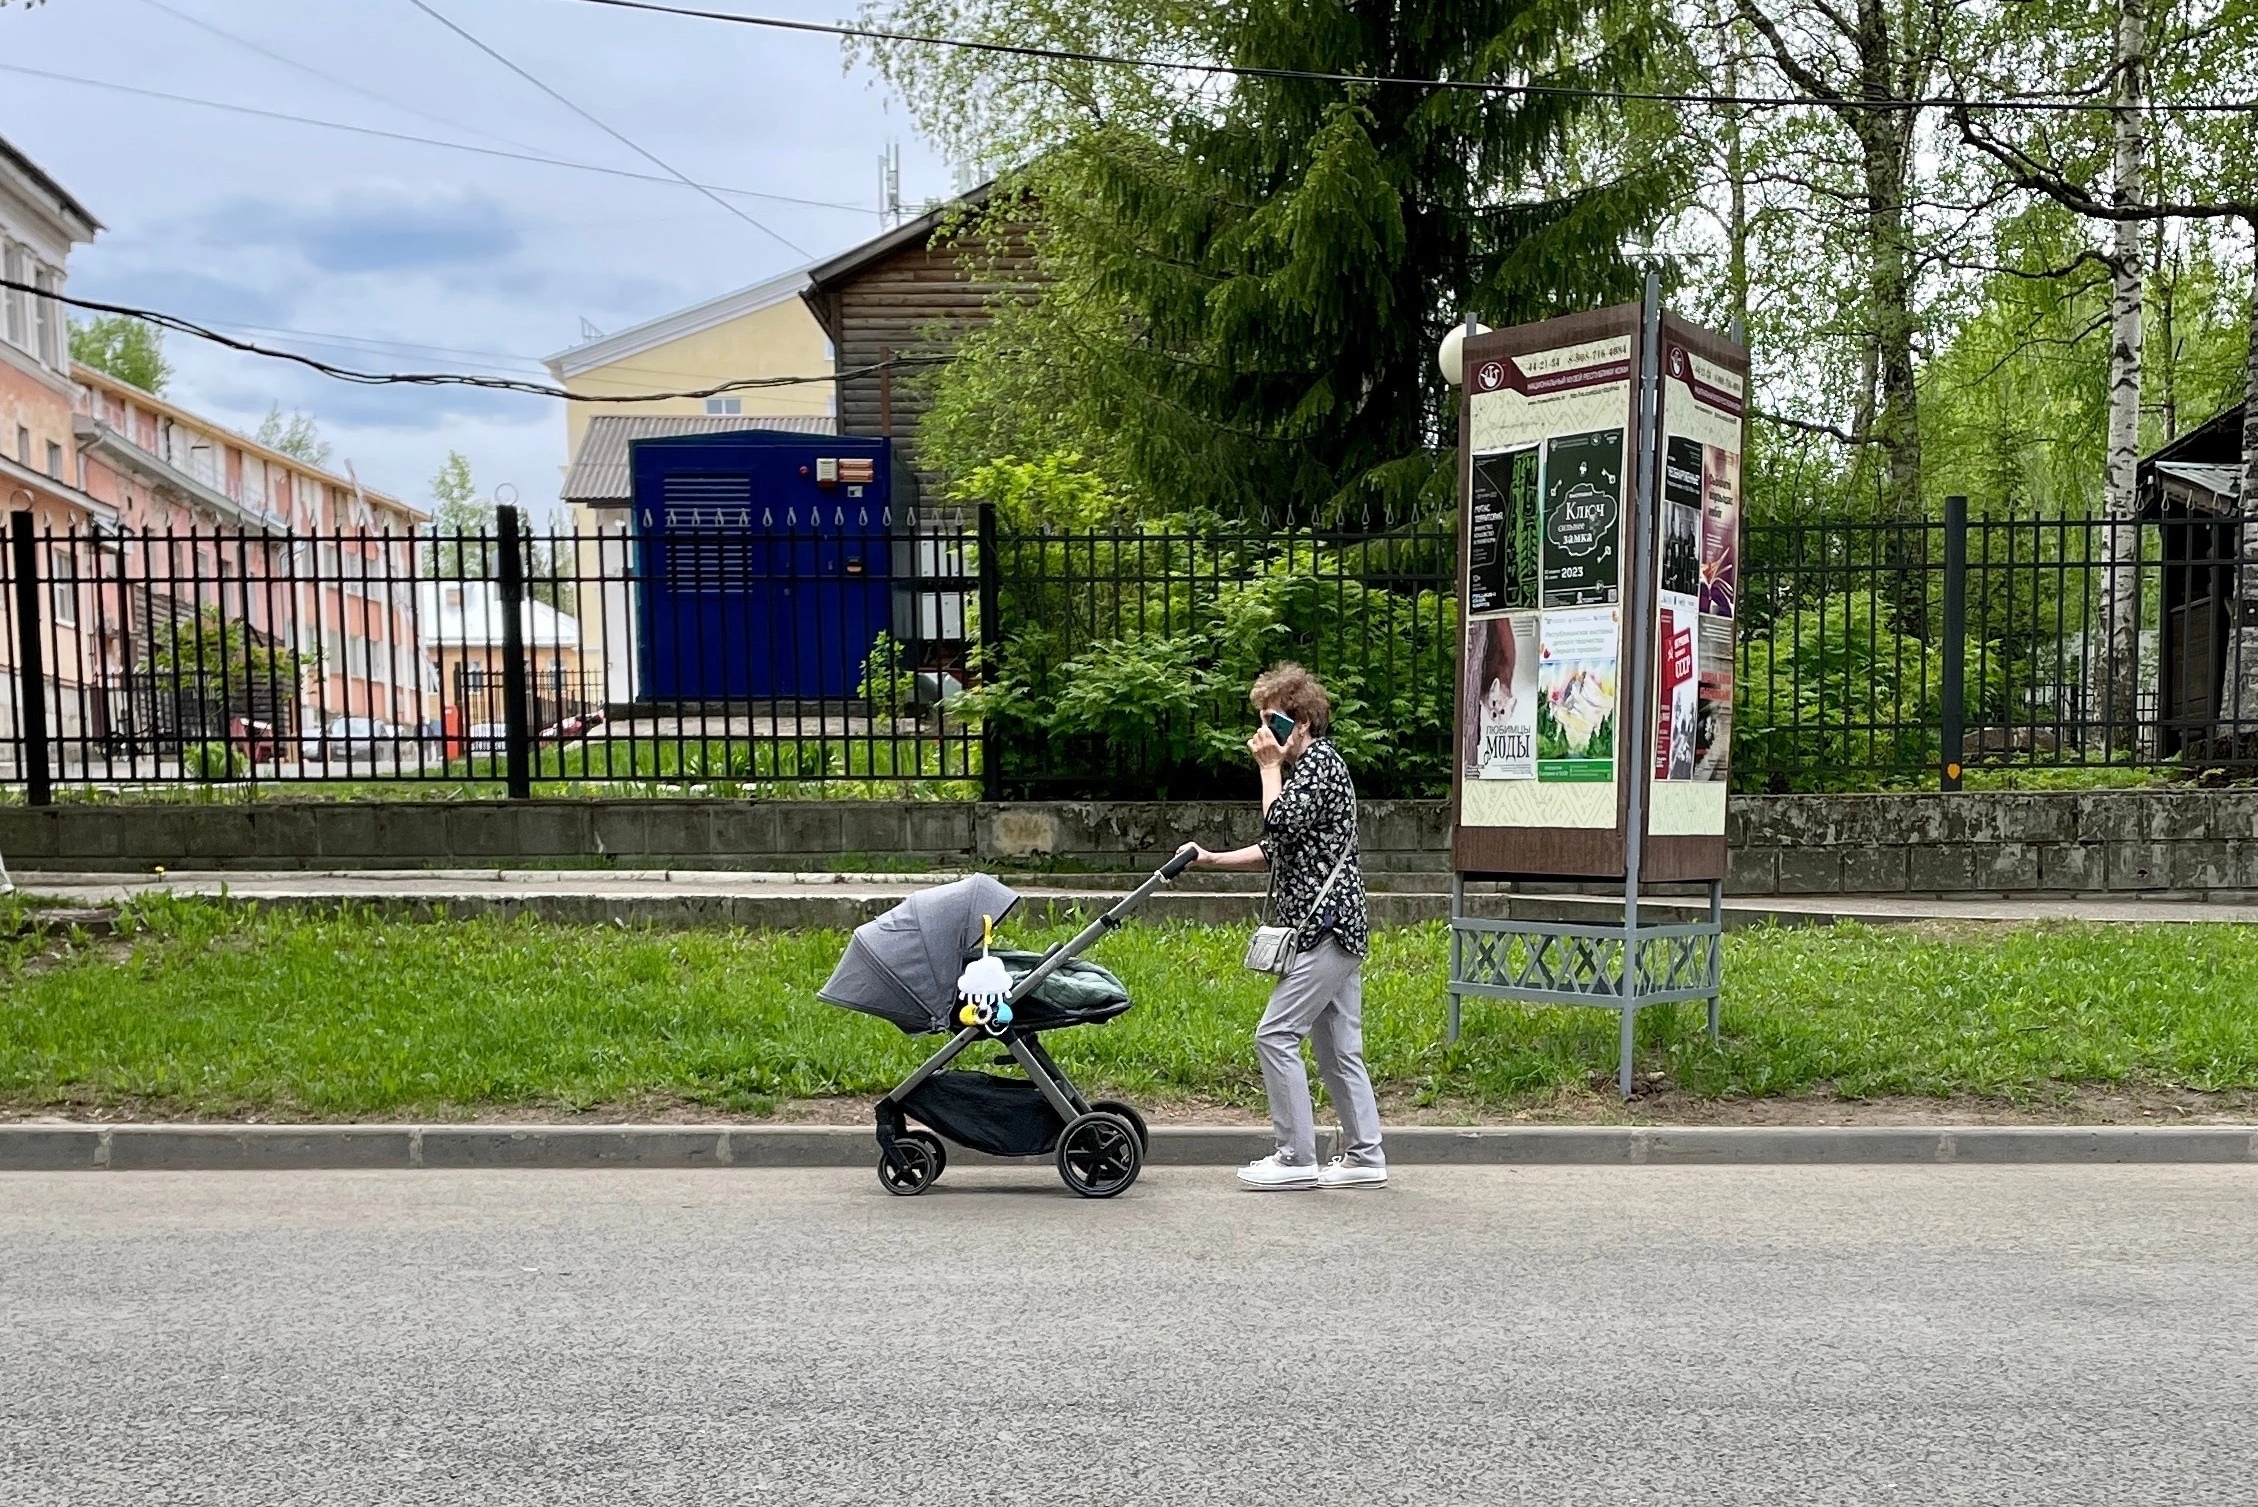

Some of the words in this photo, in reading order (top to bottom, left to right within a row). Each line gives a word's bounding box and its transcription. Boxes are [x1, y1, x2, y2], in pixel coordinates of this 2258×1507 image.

[1566, 502, 1605, 520] Ключ
[1563, 533, 1593, 545] замка
[1561, 566, 1584, 578] 2023
[1486, 725, 1531, 735] ЛЮБИМЦЫ
[1485, 735, 1531, 762] МОДЫ
